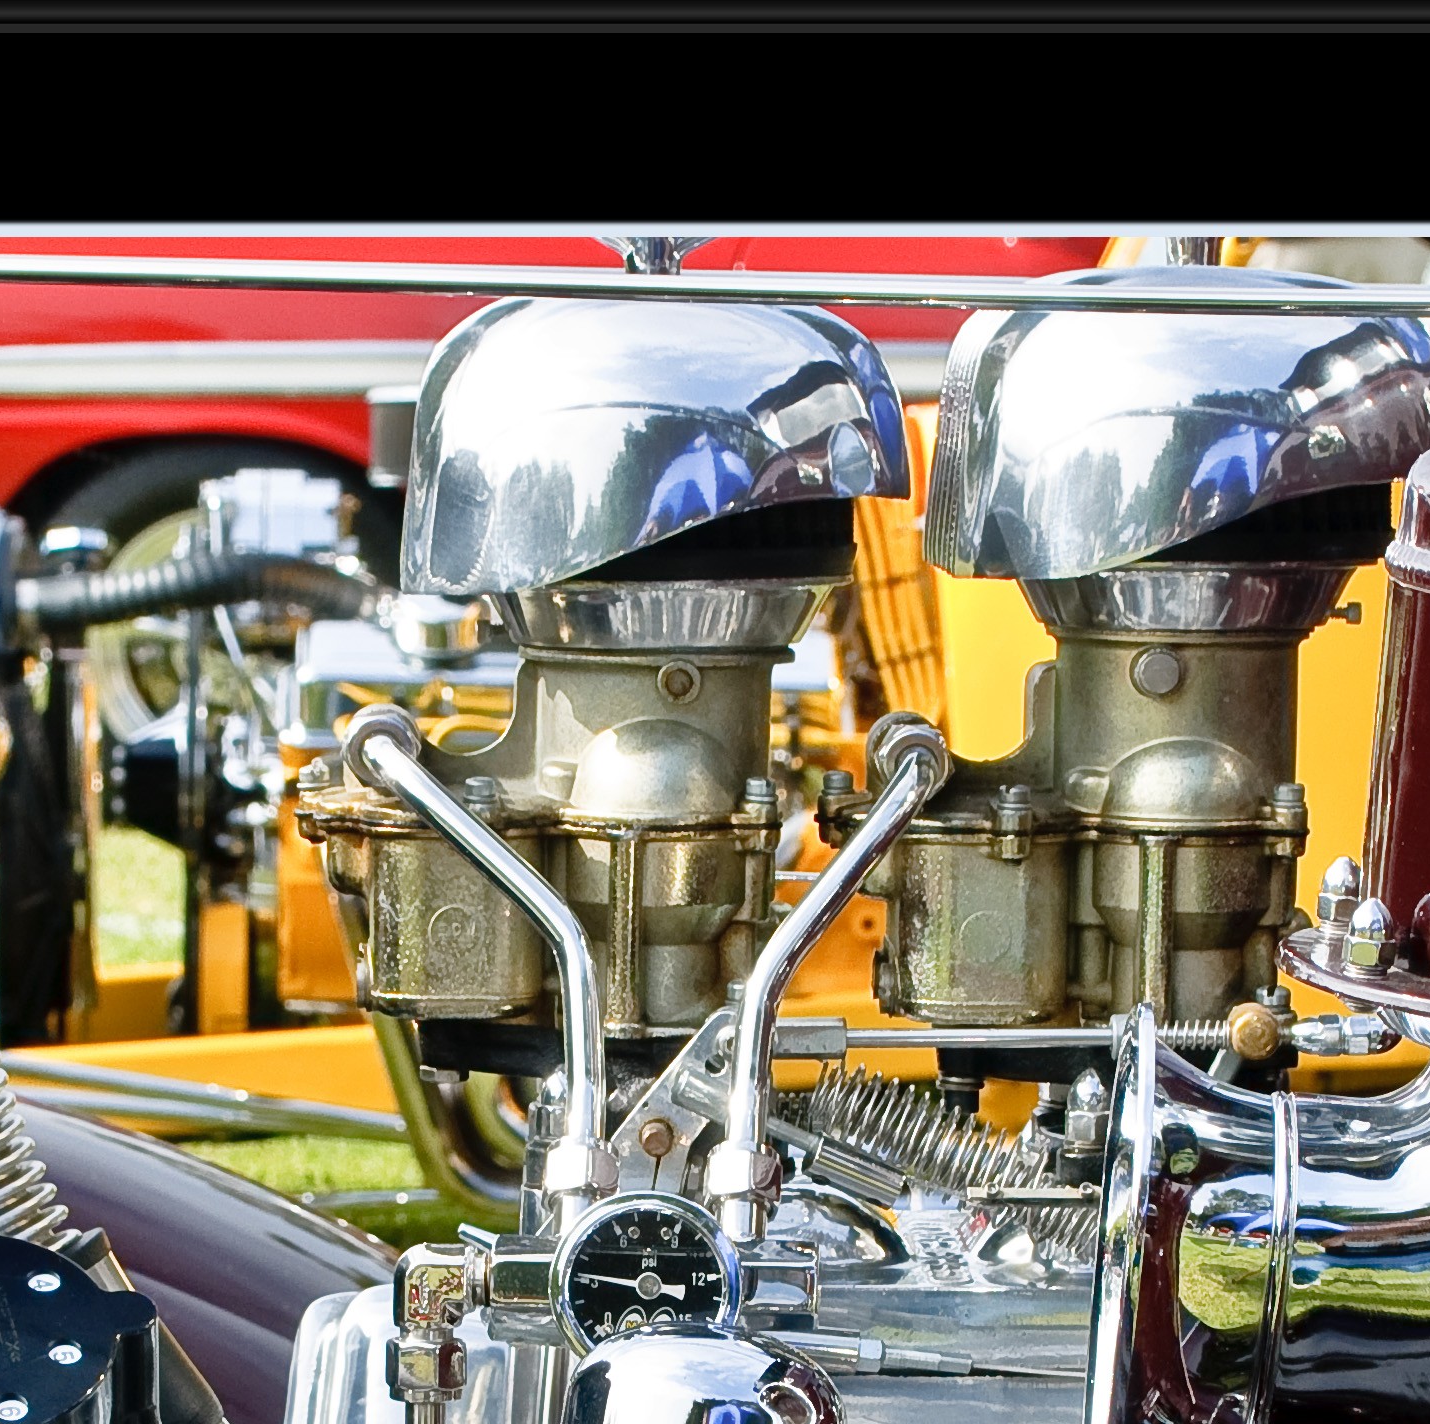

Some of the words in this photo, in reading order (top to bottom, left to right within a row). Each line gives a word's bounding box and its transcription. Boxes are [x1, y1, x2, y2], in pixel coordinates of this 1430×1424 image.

[619, 1235, 628, 1248] 6
[670, 1236, 679, 1248] 9
[641, 1256, 657, 1269] psi
[691, 1272, 706, 1286] 12
